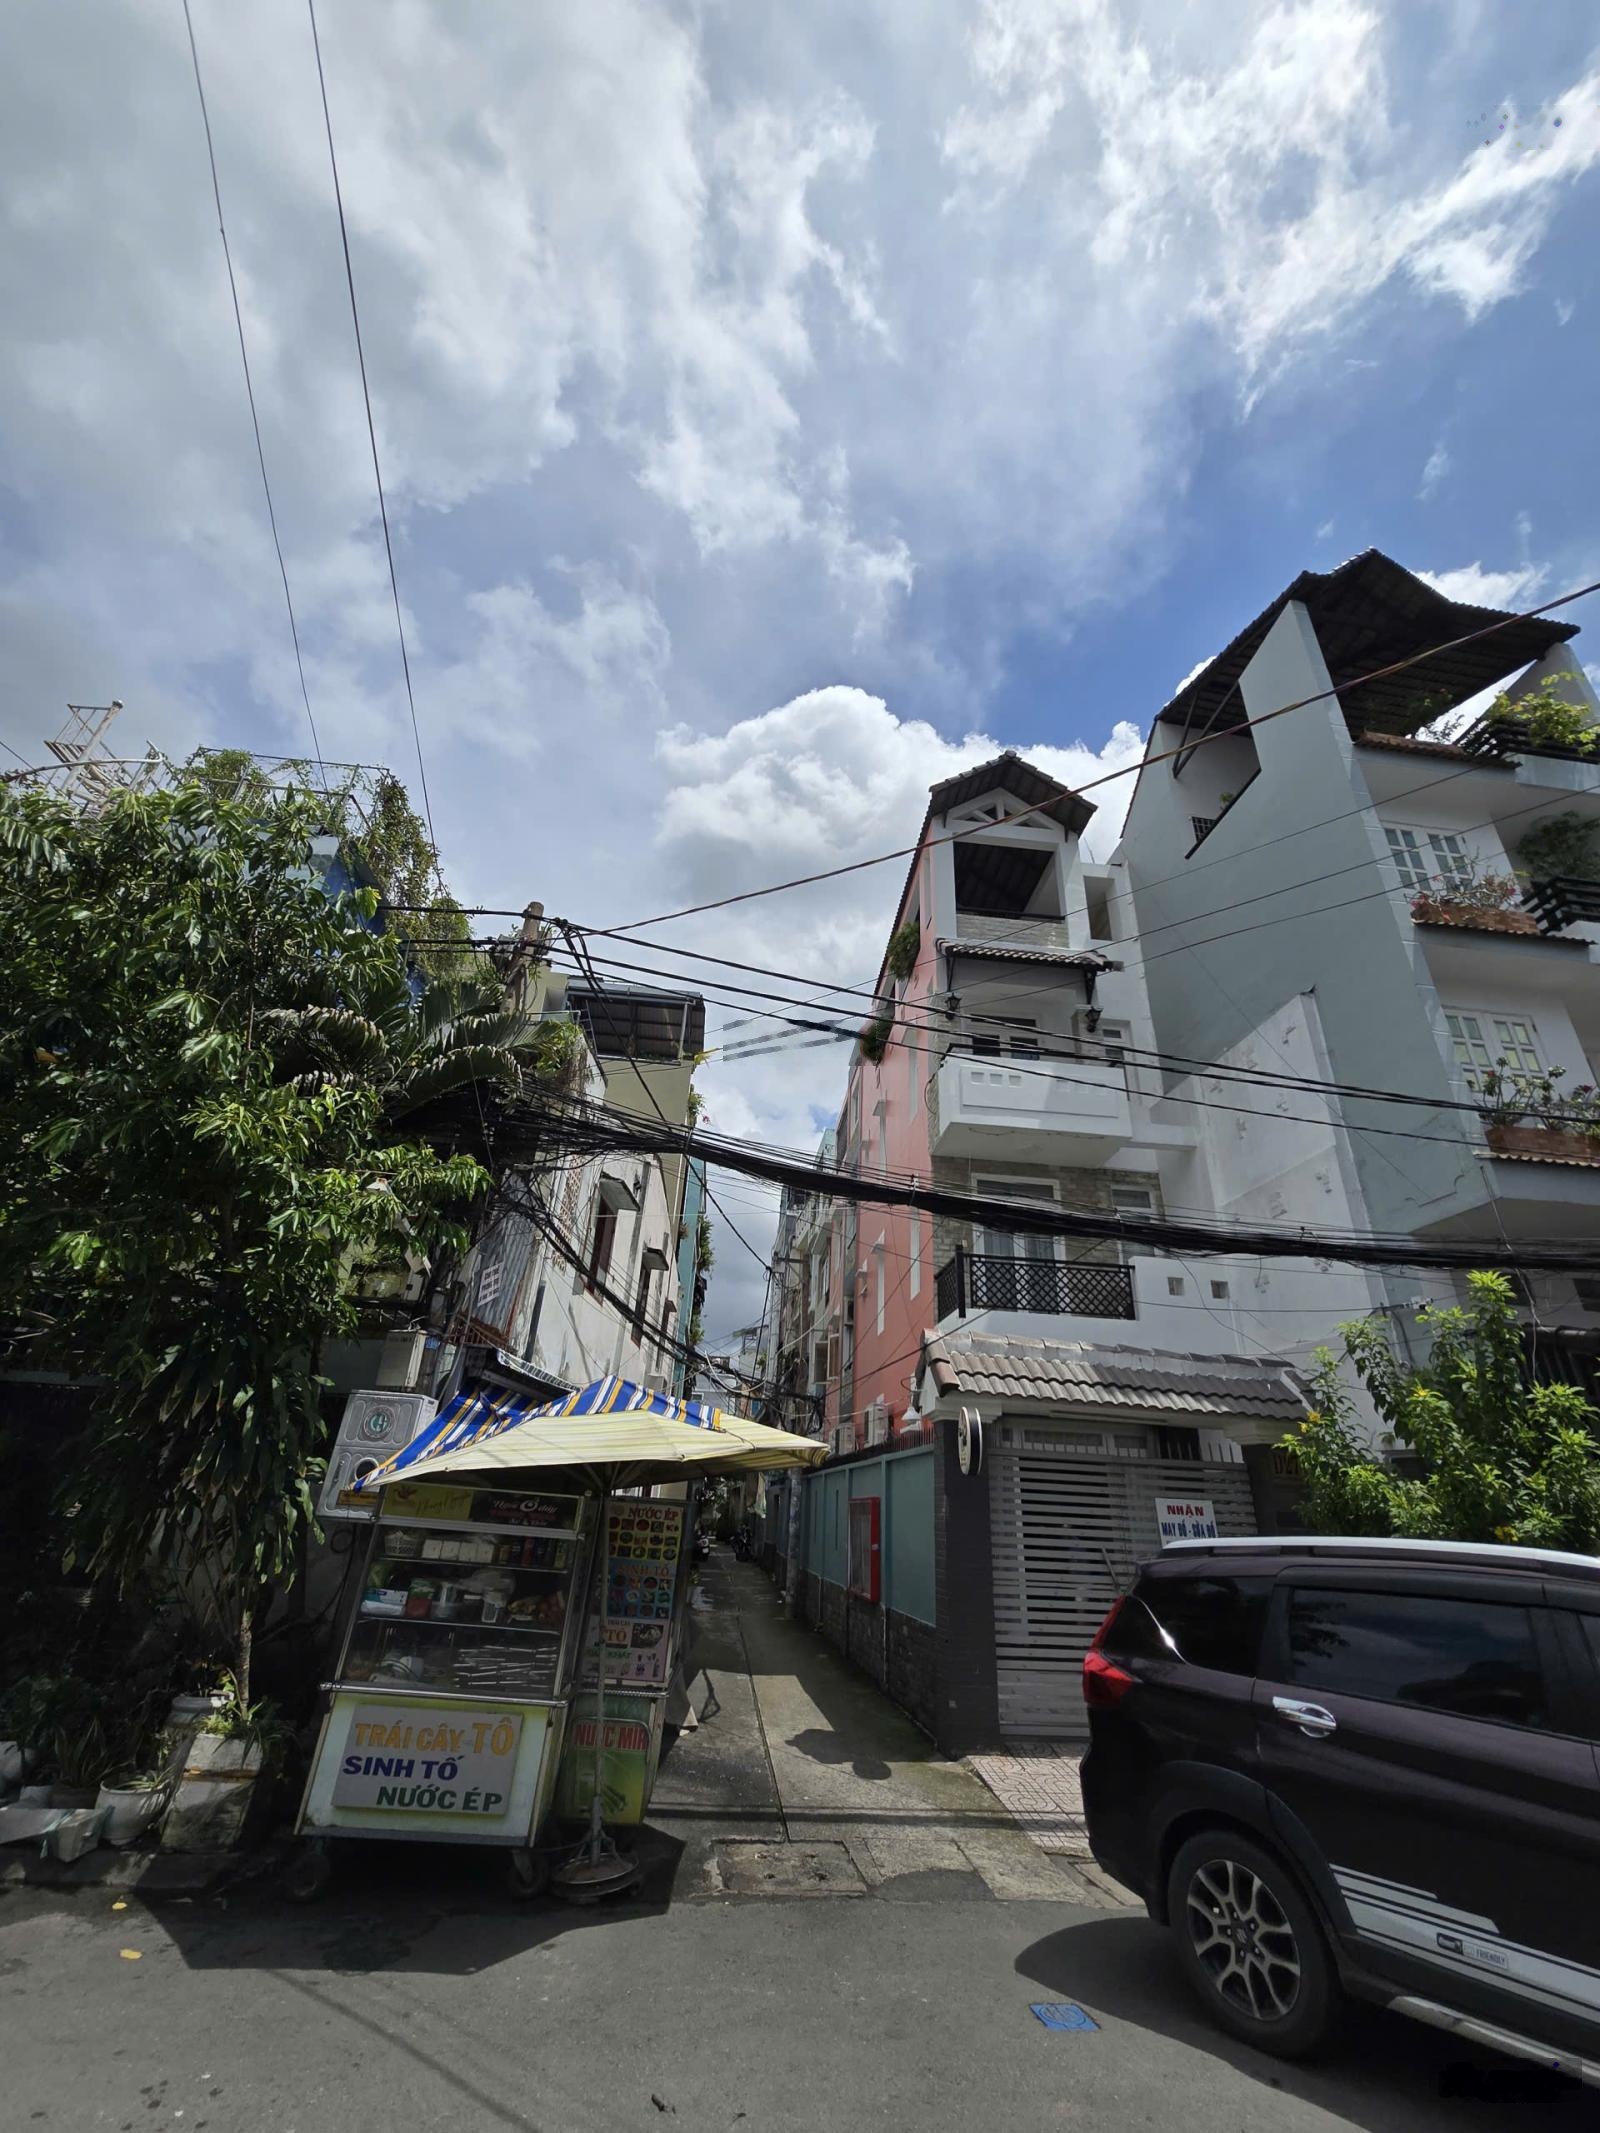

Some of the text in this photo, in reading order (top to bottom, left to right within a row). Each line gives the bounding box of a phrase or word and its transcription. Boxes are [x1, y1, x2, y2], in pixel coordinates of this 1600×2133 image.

[355, 1716, 513, 1756] TRÁI CÂY TÔ
[343, 1755, 465, 1781] SINH TỐ
[376, 1784, 503, 1812] NƯỚC ÉP
